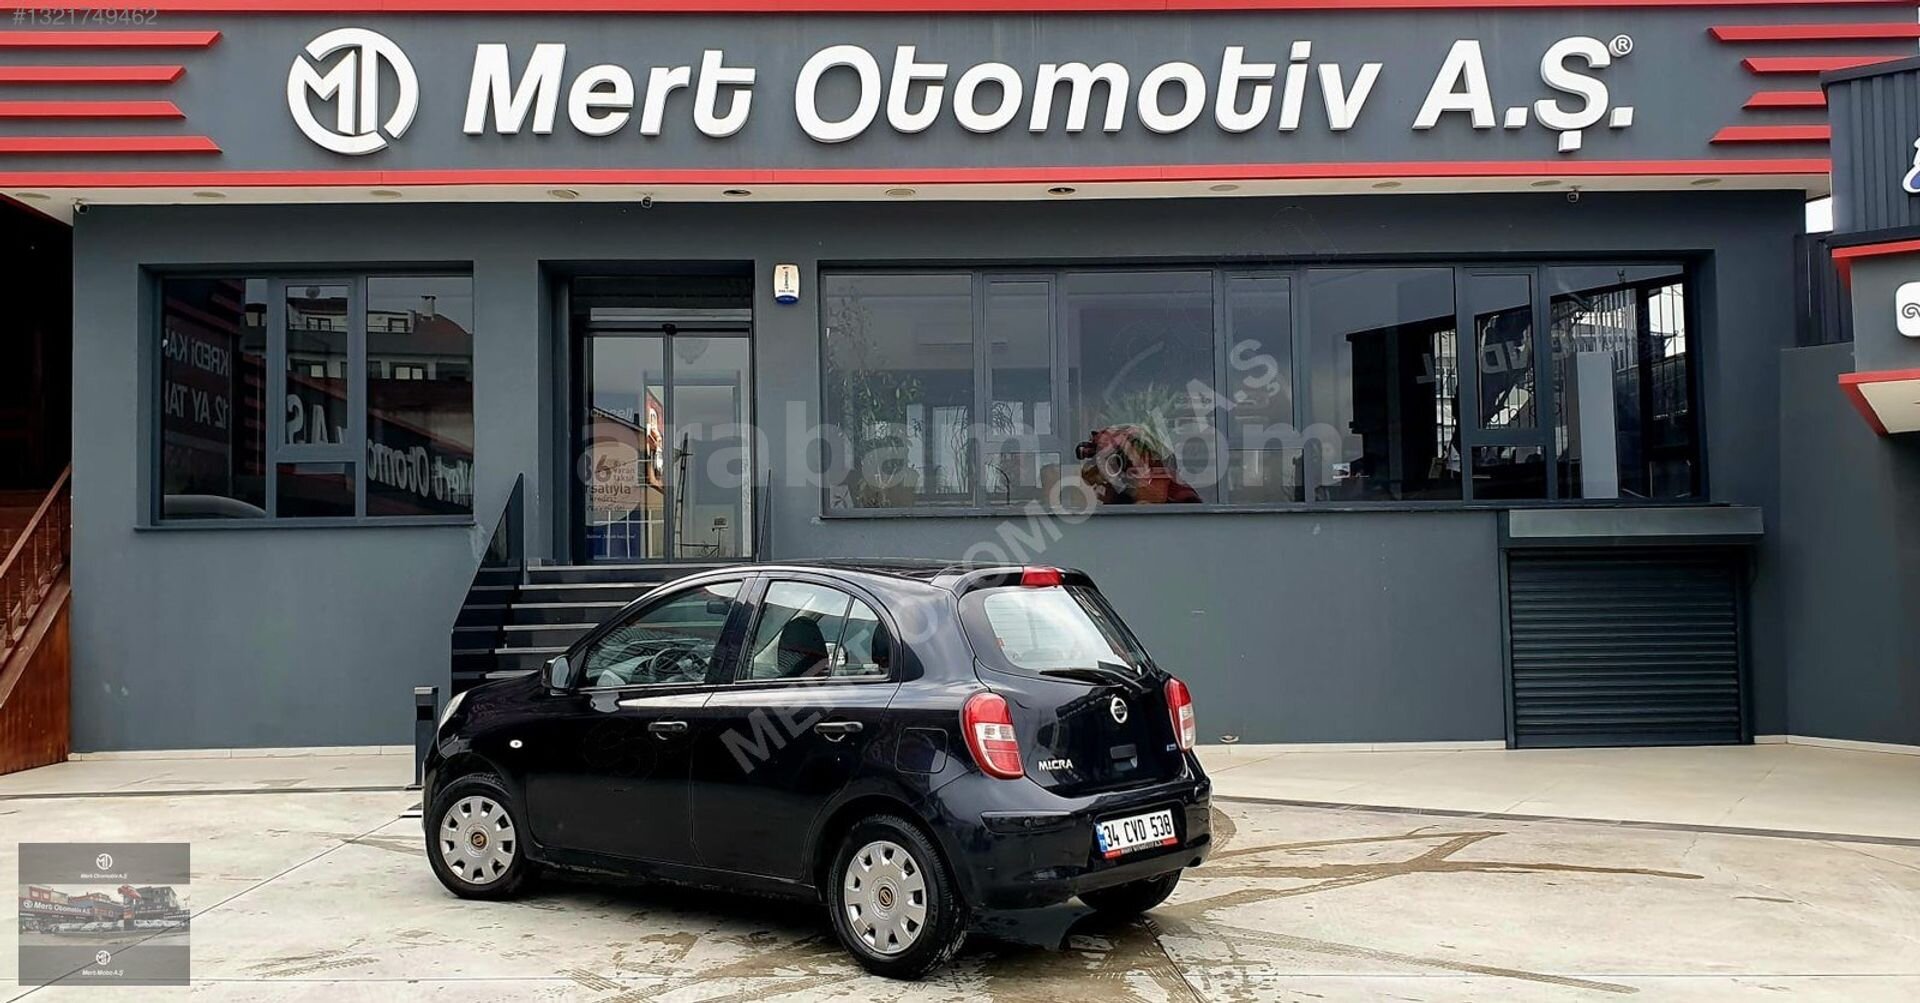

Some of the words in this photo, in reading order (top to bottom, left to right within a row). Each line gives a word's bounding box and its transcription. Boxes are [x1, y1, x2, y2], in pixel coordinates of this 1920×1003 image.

[463, 42, 756, 138] Mert
[794, 40, 1383, 144] Otomotiv
[1038, 758, 1074, 771] MICRA
[1104, 823, 1120, 848] 34
[1123, 819, 1147, 843] CVD
[1149, 814, 1172, 837] 538
